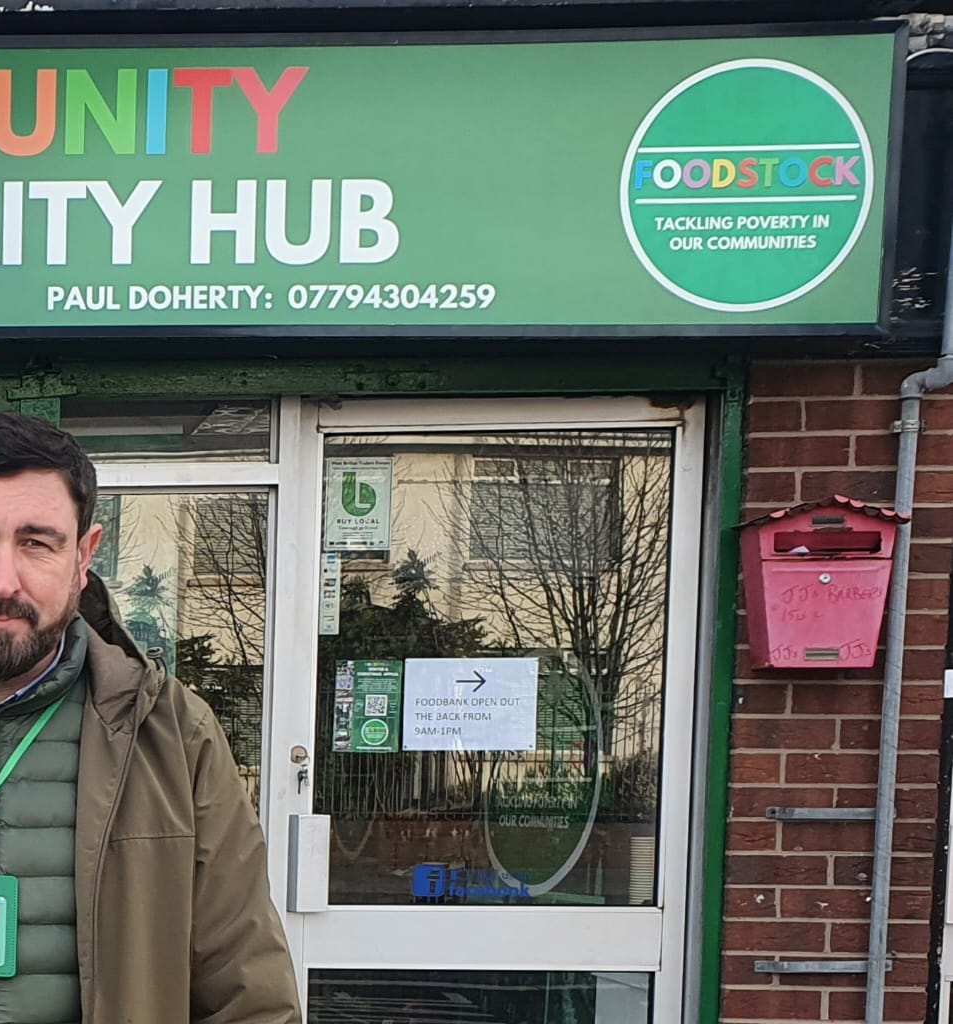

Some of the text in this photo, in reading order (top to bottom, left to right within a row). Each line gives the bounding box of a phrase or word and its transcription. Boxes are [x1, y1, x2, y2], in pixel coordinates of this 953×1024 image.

[634, 155, 860, 190] FOODSTOCK
[190, 178, 399, 266] HUB
[655, 214, 830, 231] TACKLING POVERTY IN
[669, 235, 817, 251] OUR COMMUNITIES
[47, 283, 496, 311] PAUL DOHERTY: 07794304259
[415, 697, 521, 707] FOODBANK OPEN OUT
[415, 712, 492, 721] THE BACK FROM
[414, 727, 462, 736] 9AM-1PM
[499, 815, 569, 829] OUR COMMUNITIES
